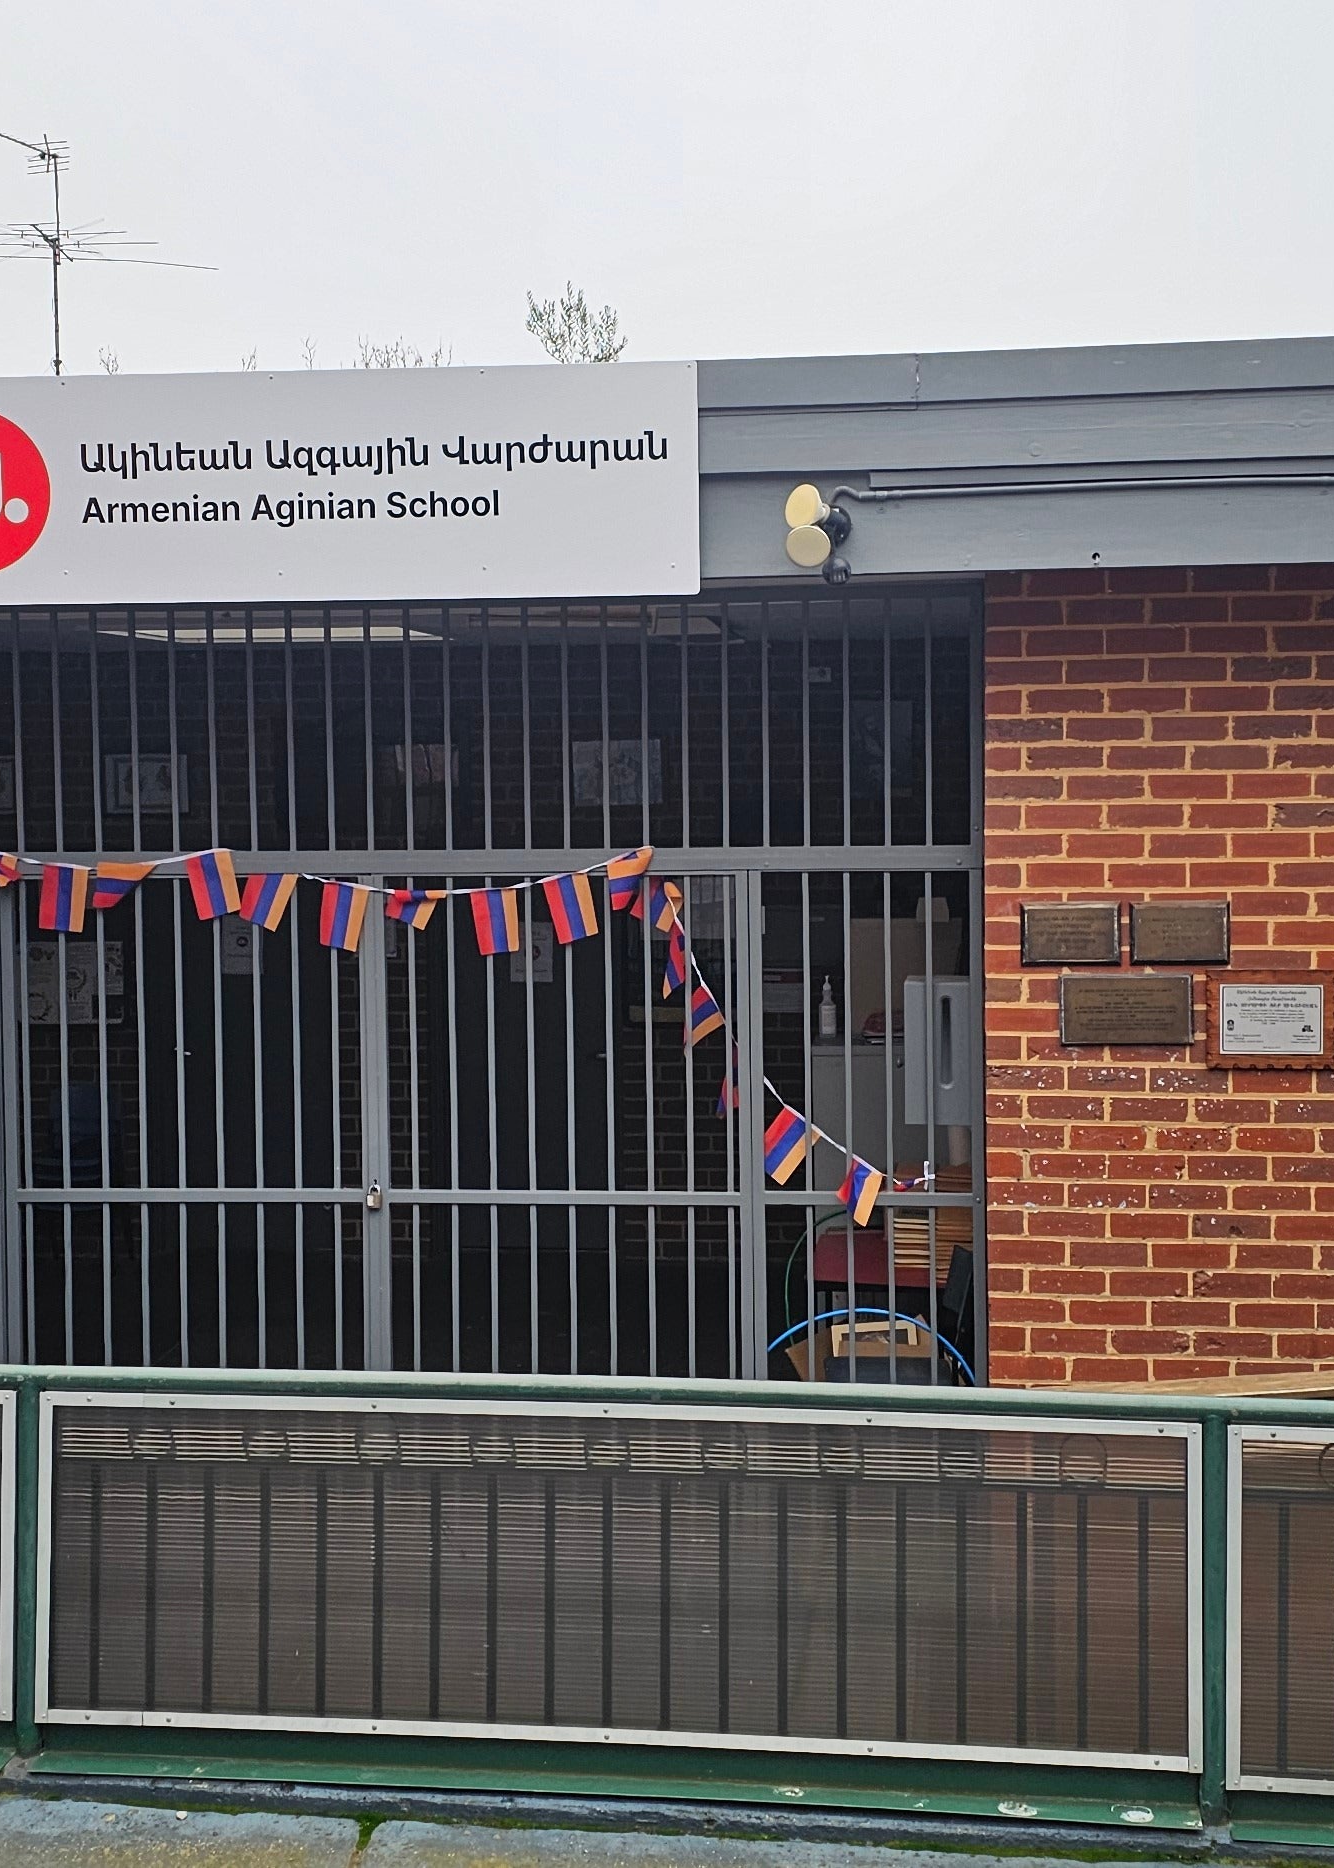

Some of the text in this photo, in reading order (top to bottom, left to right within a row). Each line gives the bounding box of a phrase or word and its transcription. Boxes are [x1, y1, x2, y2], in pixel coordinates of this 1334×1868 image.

[80, 430, 668, 480] Ակինեան Ազգային Վարժարան
[81, 489, 500, 528] Armenian Aginian School
